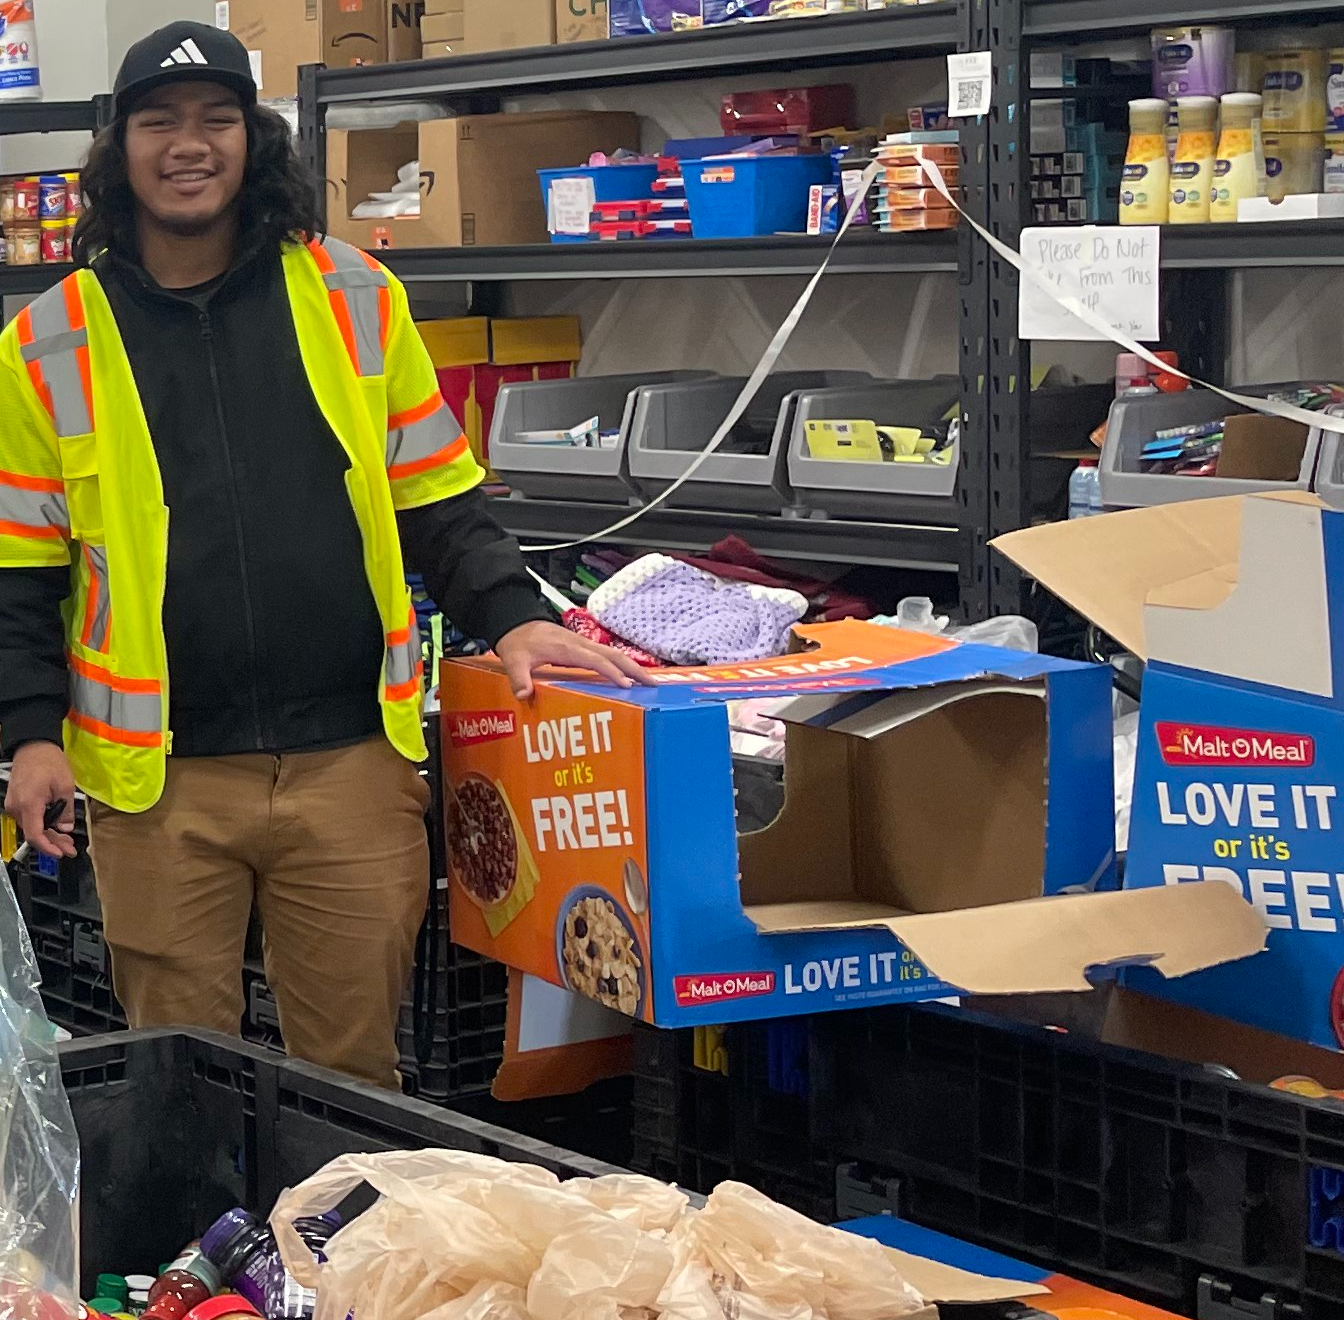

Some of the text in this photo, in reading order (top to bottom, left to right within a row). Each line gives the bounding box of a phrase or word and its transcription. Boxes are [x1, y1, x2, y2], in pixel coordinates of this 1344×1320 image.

[1038, 237, 1151, 263] Please Do Not
[1079, 266, 1113, 288] From
[1122, 267, 1152, 286] This
[777, 655, 873, 677] LOVE
[522, 711, 613, 763] LOVE IT
[554, 762, 594, 787] or it's
[1156, 781, 1337, 830] LOVE IT
[531, 789, 634, 852] FREE!
[1213, 834, 1291, 861] or it's
[785, 956, 860, 994] LOVE
[869, 951, 897, 984] IT
[900, 966, 922, 981] it's
